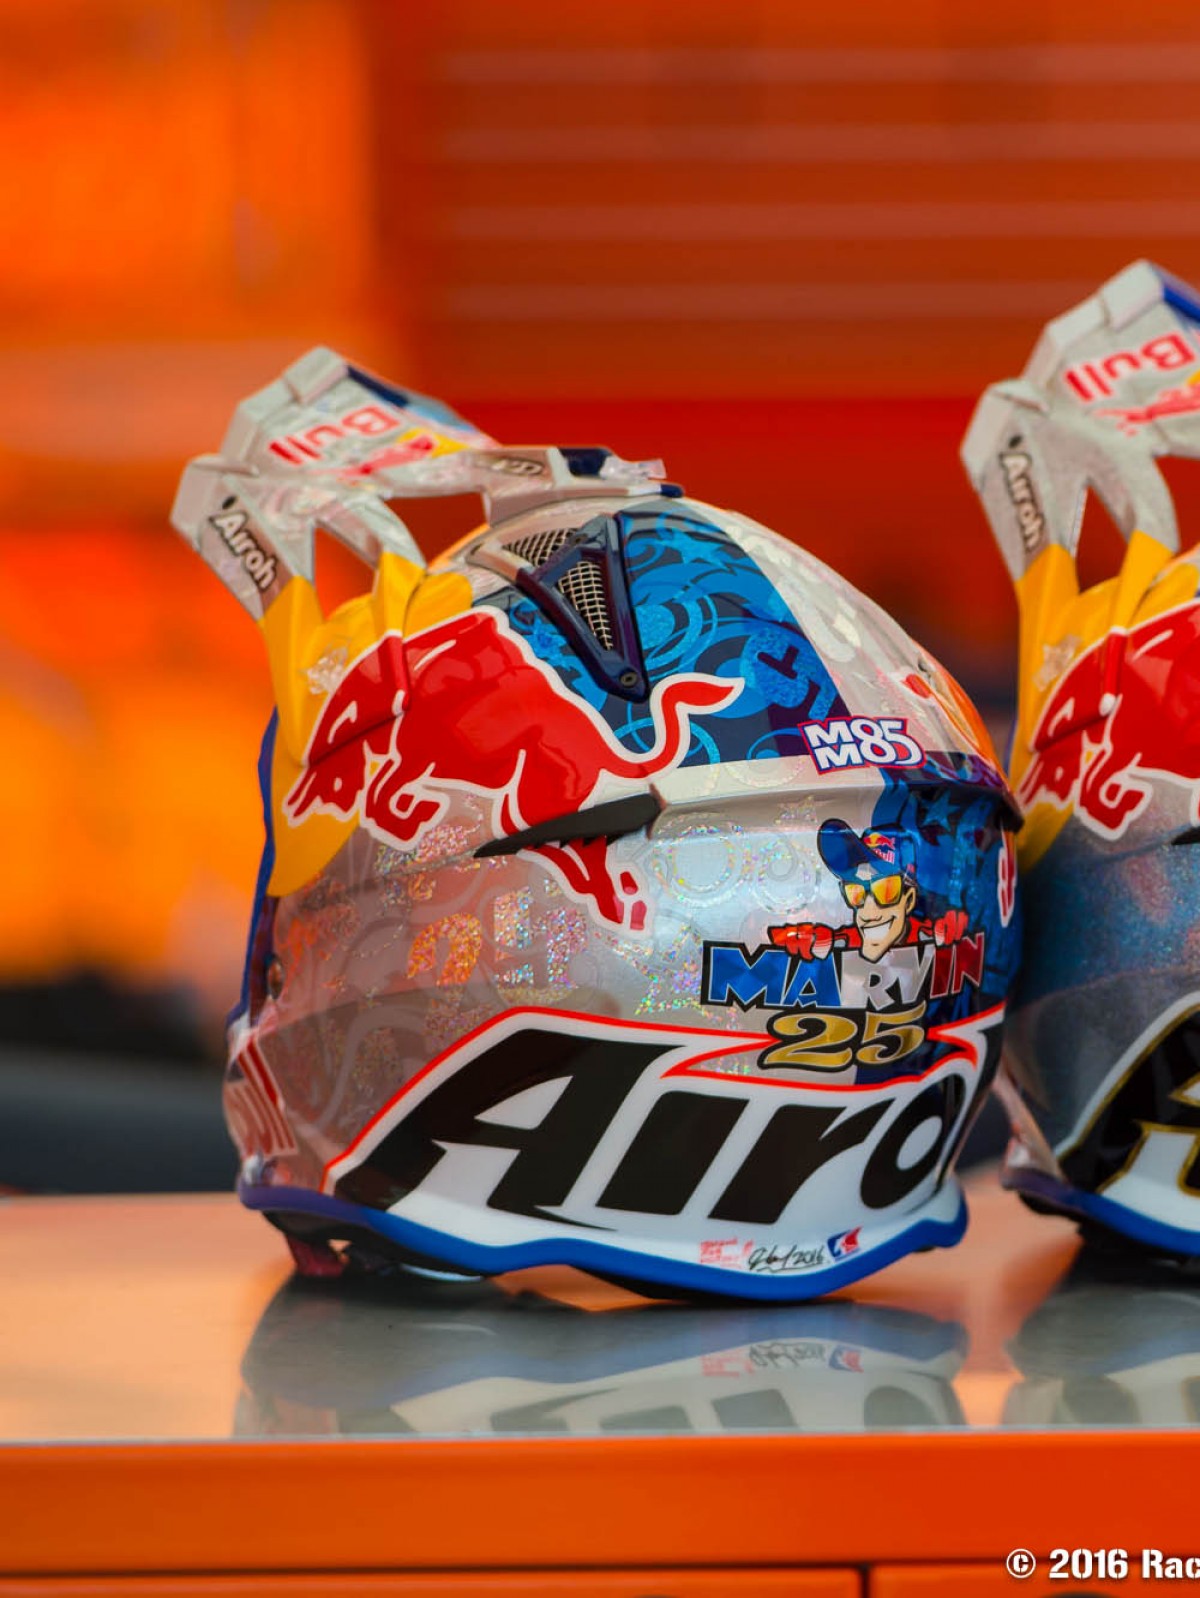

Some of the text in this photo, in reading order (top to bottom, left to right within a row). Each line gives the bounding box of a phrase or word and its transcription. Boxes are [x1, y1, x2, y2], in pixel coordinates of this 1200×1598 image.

[1063, 333, 1196, 403] Bull
[269, 405, 401, 466] Bull
[208, 510, 278, 592] Airoh
[708, 932, 985, 1011] MARVIN
[762, 1001, 927, 1068] 25
[330, 1020, 1003, 1232] Airo
